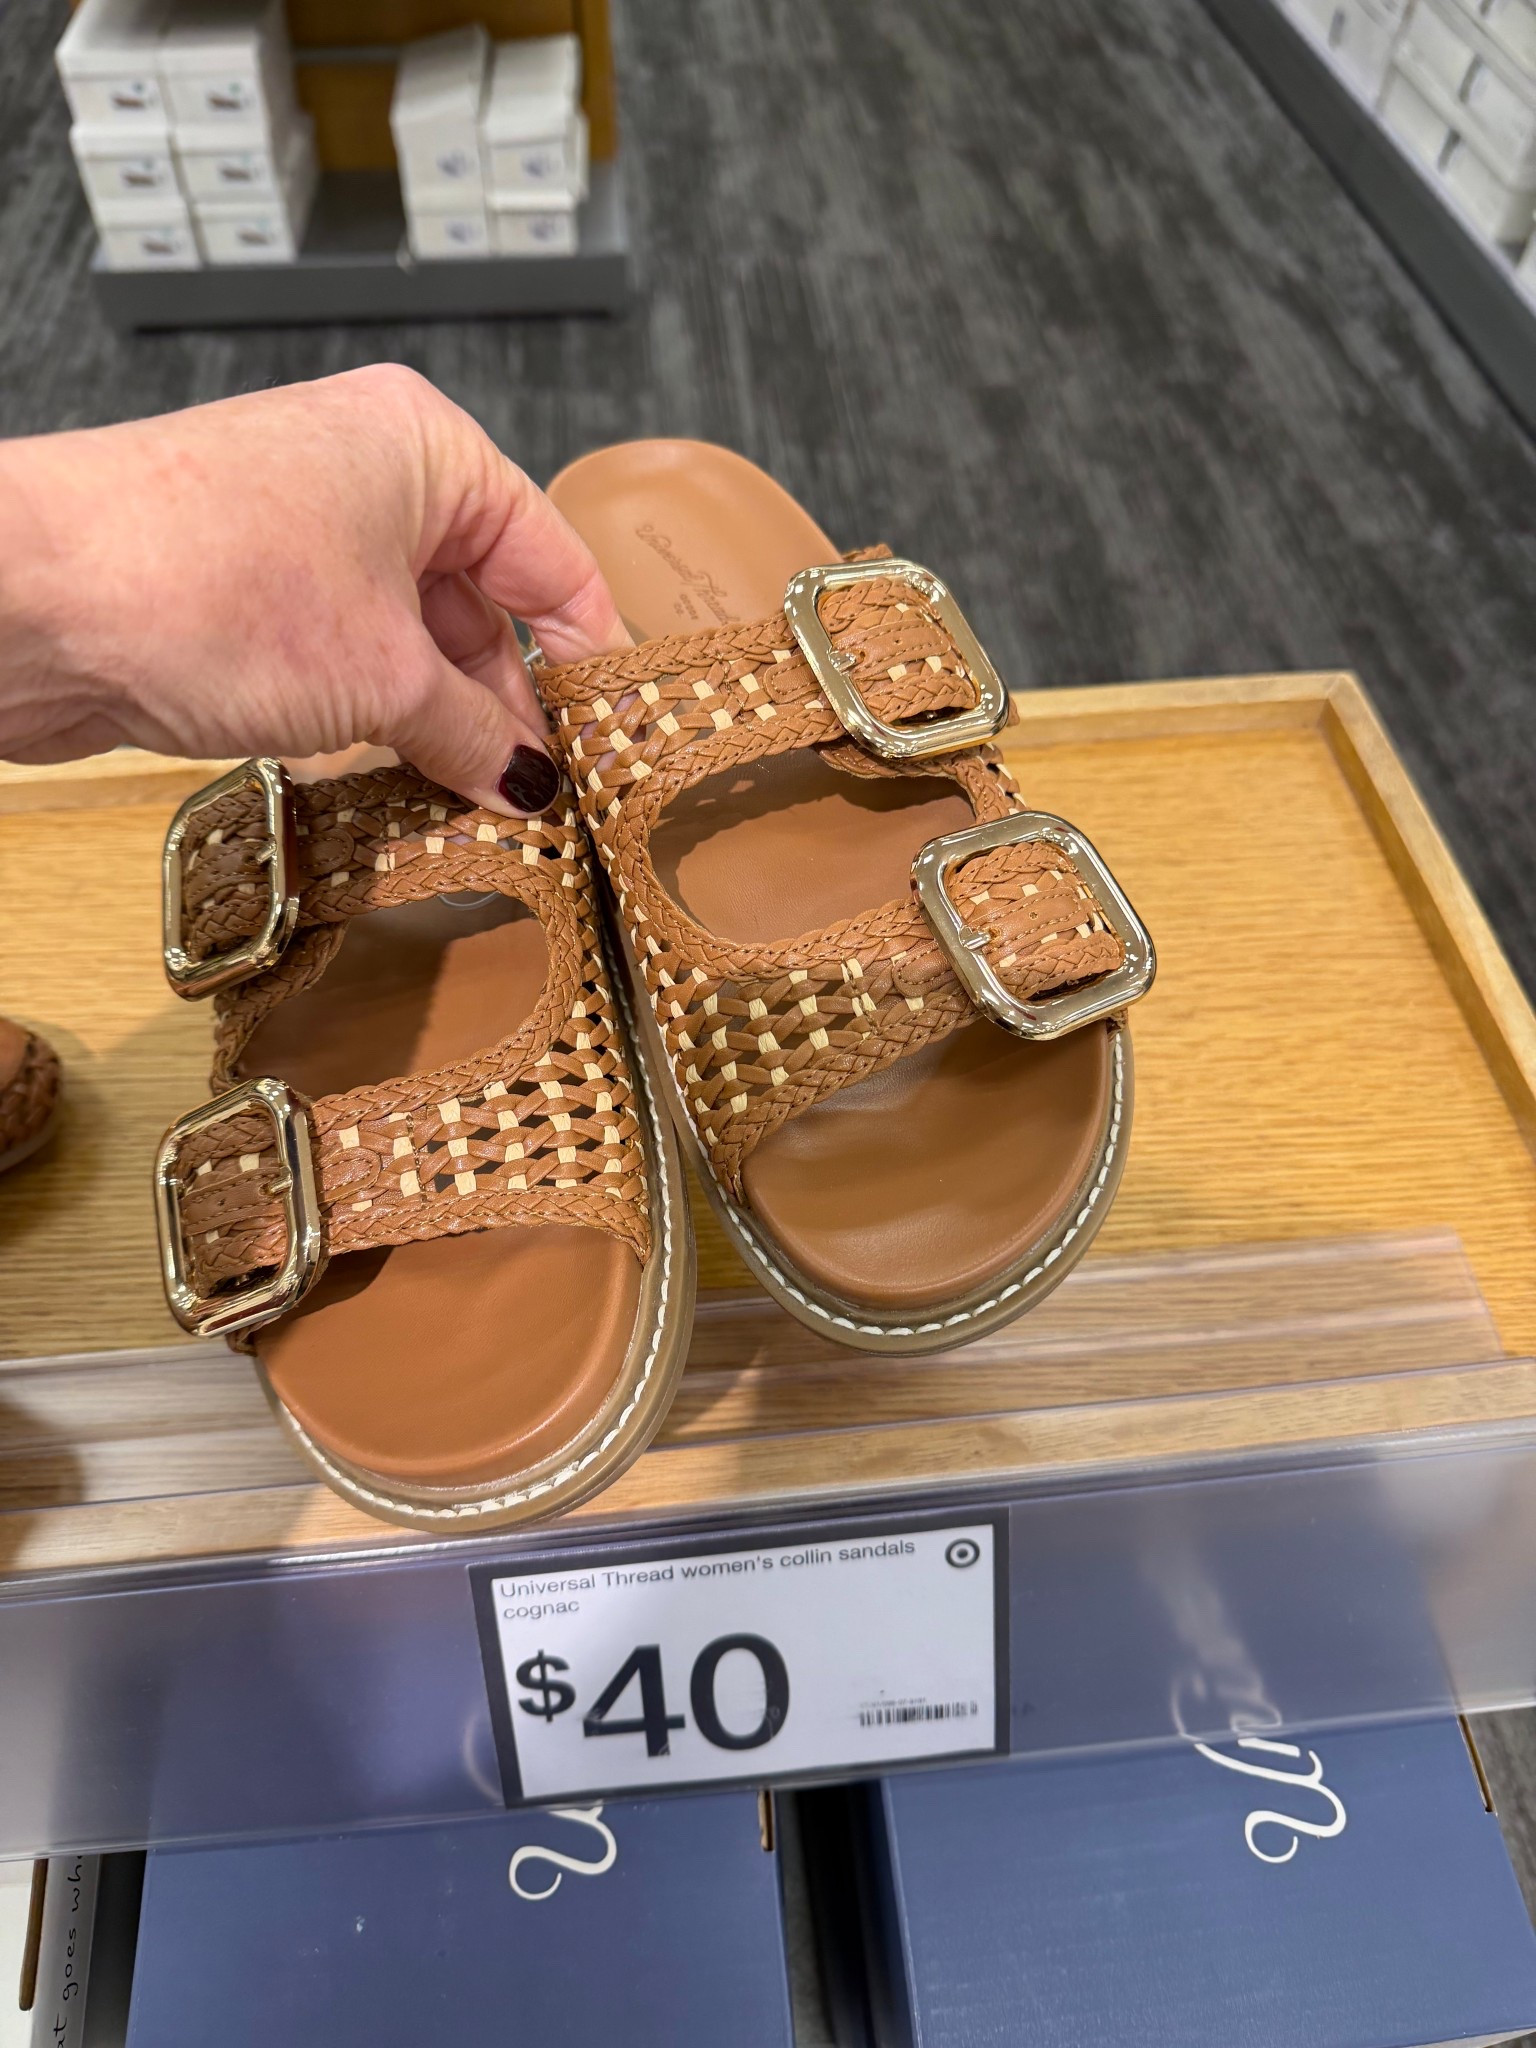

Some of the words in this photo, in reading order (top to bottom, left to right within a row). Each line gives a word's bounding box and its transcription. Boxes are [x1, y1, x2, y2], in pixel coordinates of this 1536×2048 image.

[500, 1574, 596, 1597] Universal
[602, 1565, 674, 1587] Thread
[681, 1556, 773, 1578] women's
[780, 1548, 832, 1567] collin
[839, 1539, 915, 1561] sandals
[503, 1600, 580, 1620] cognac
[515, 1632, 790, 1757] $40
[62, 1927, 80, 2001] goes
